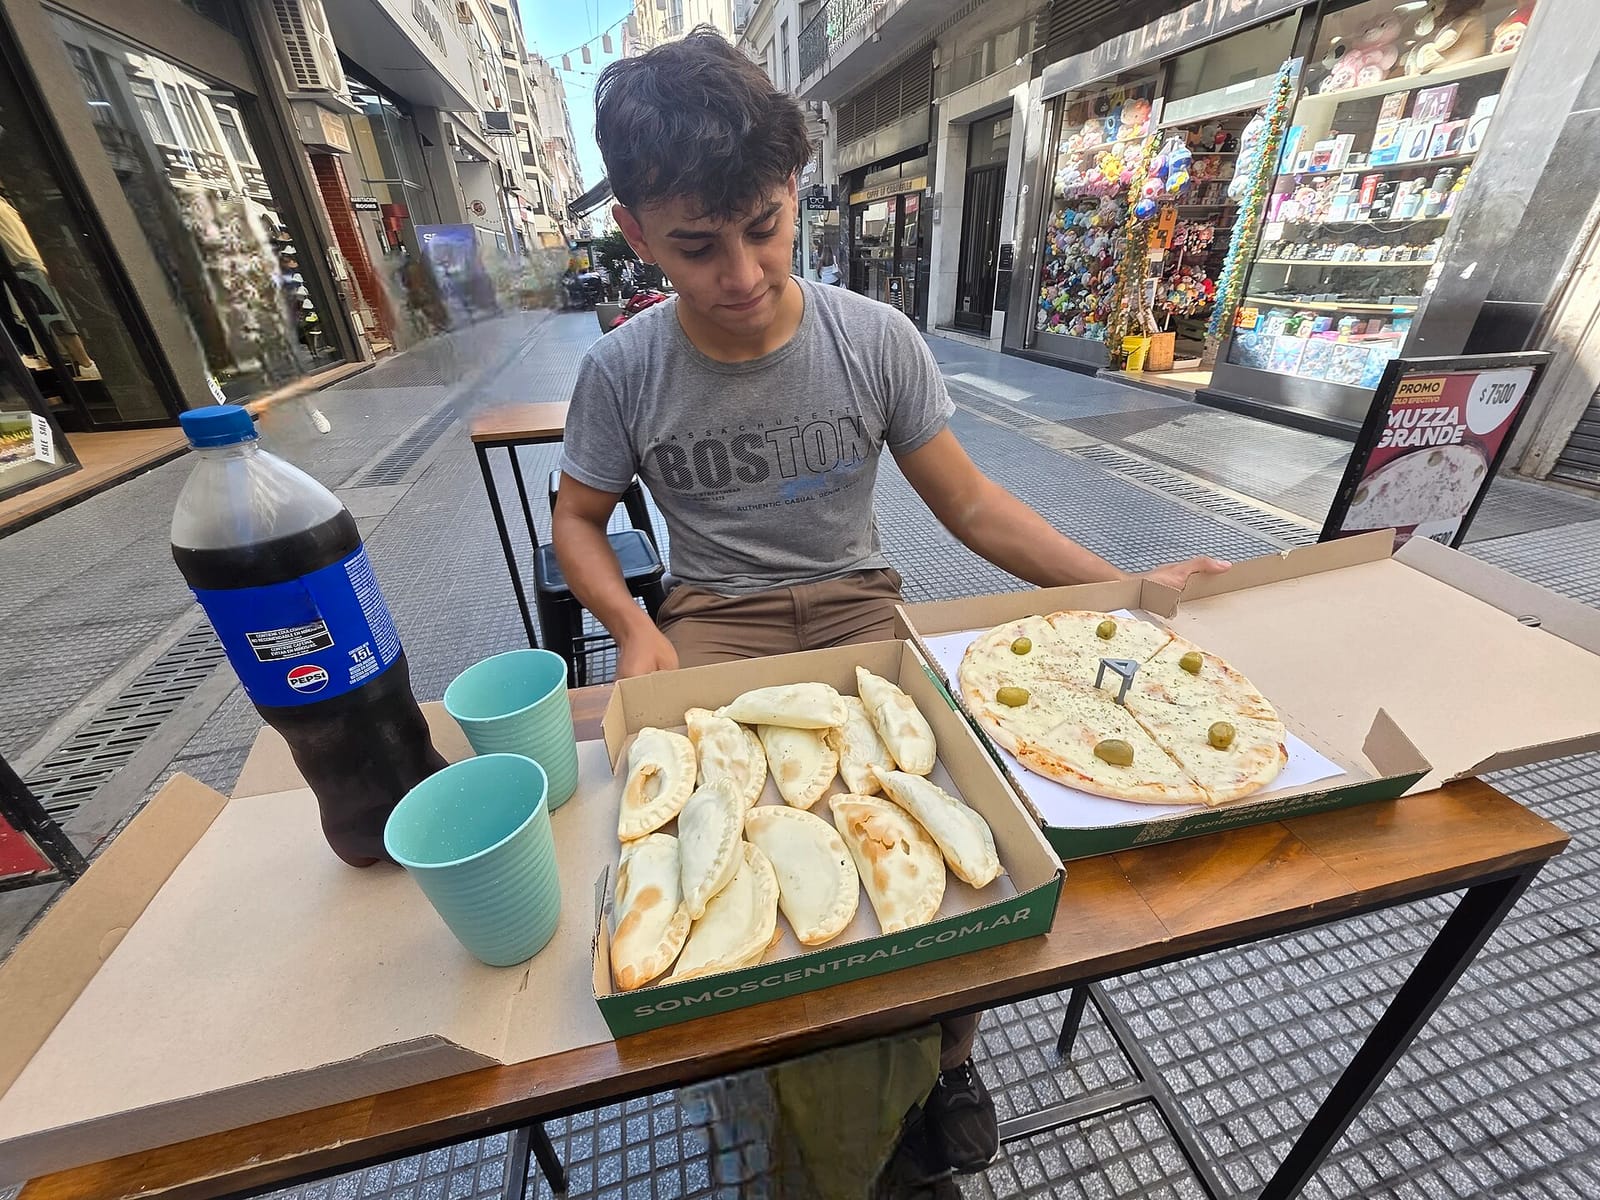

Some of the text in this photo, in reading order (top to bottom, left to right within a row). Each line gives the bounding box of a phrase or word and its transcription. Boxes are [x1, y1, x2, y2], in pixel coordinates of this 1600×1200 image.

[1398, 382, 1441, 394] PROMO
[1387, 406, 1460, 429] MUZZA
[1377, 424, 1467, 448] GRANDE
[652, 415, 872, 491] BOSTON
[737, 501, 781, 512] AUTHENTIC
[784, 495, 815, 505] CASUAL
[290, 672, 326, 685] PEPSI
[633, 907, 1032, 1018] SOMOSCENTRAL.COM.AR
